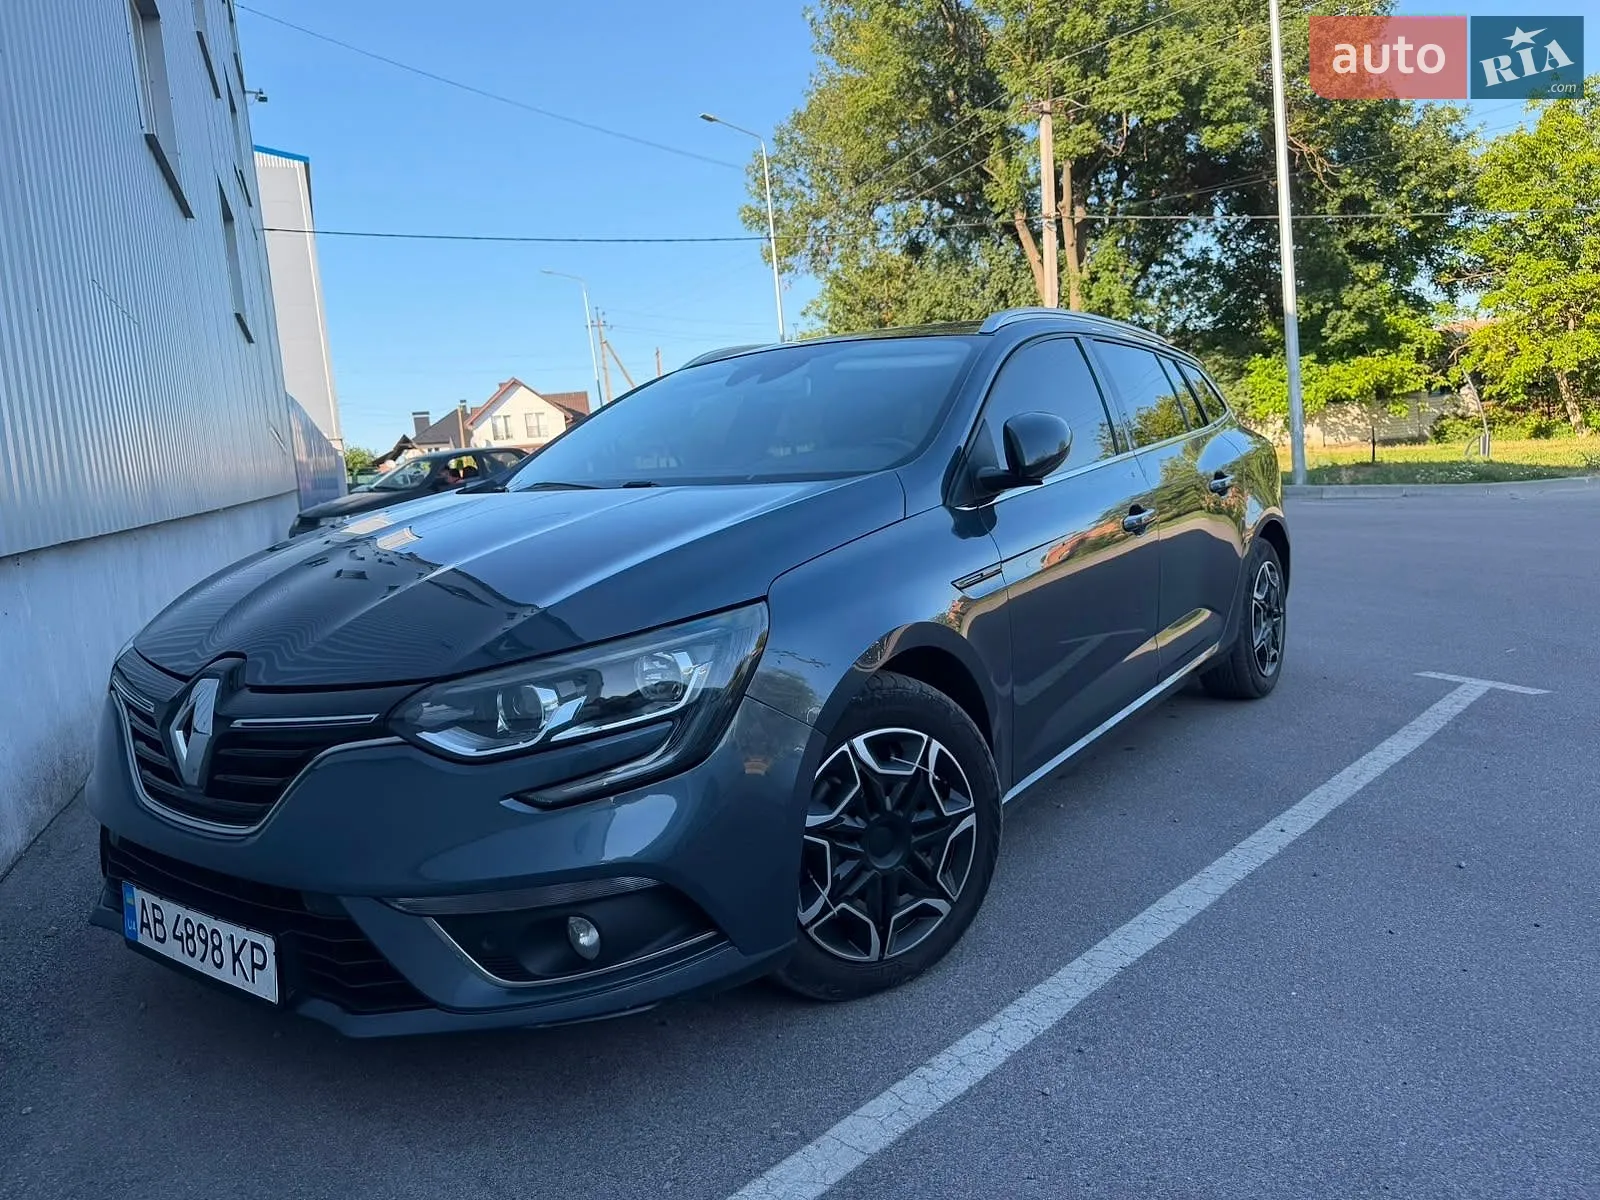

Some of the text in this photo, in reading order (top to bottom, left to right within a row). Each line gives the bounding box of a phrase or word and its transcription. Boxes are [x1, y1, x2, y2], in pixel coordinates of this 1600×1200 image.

[126, 920, 137, 931] UA
[140, 898, 268, 984] AB 4898 KP
